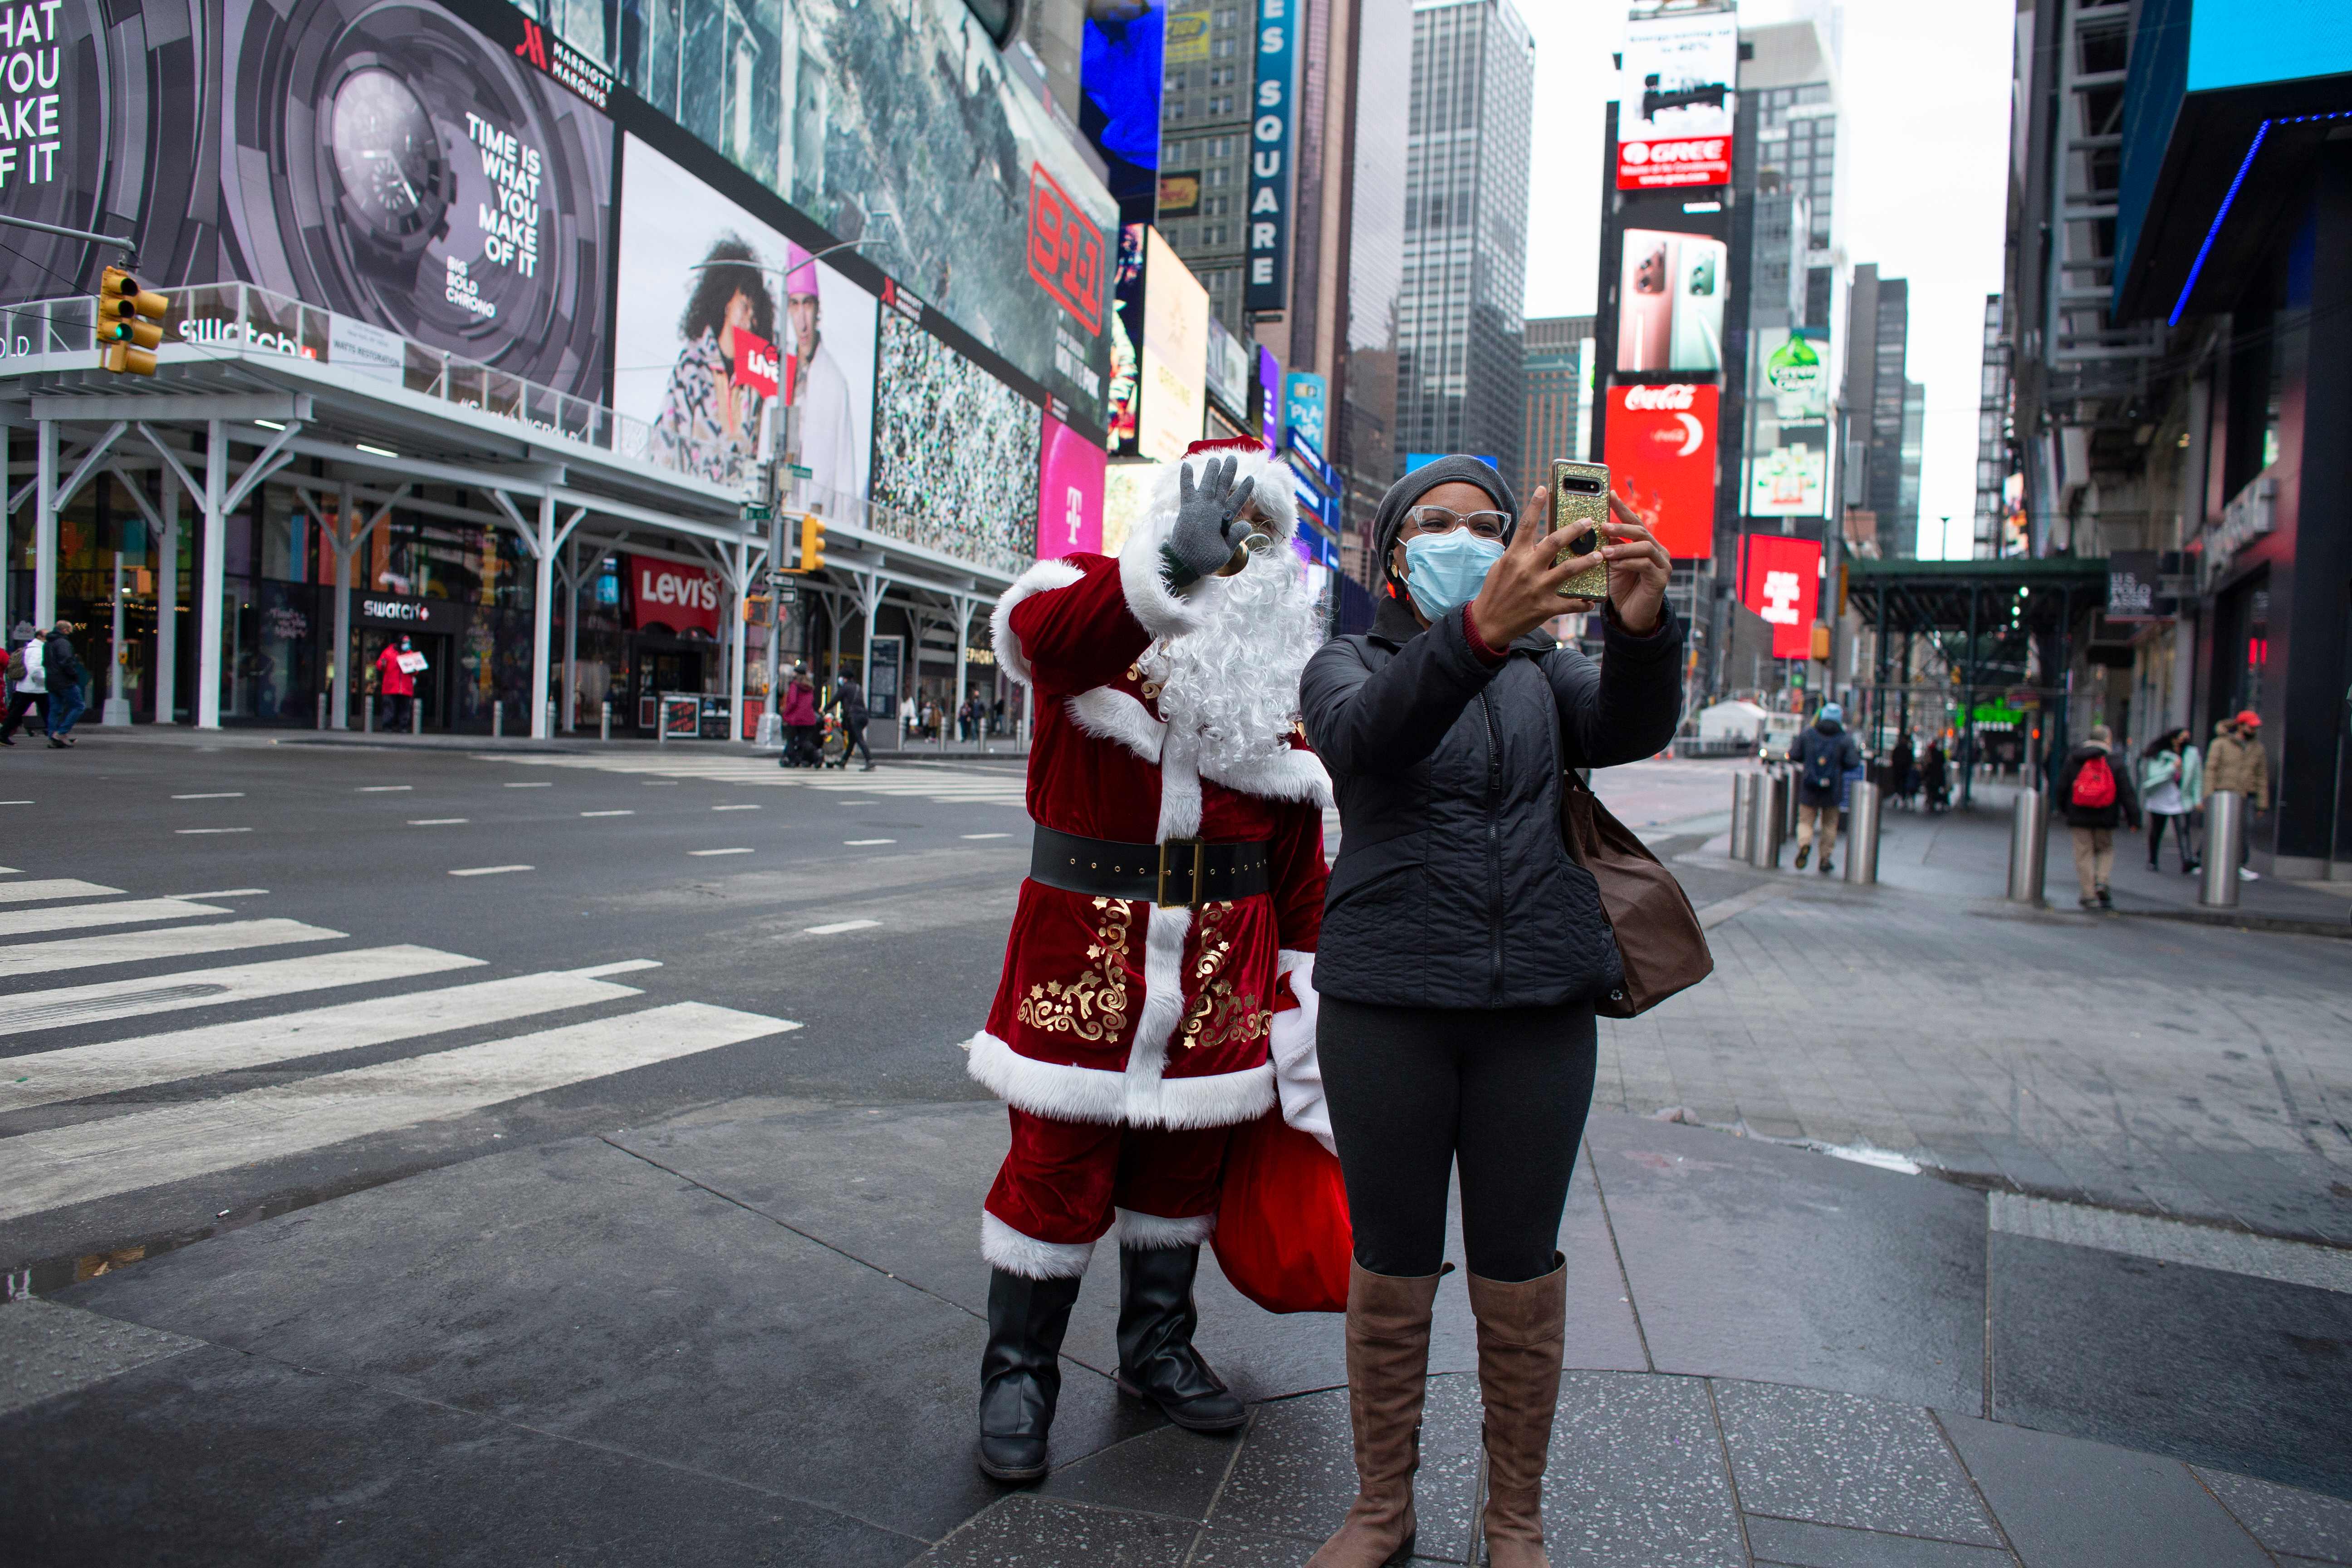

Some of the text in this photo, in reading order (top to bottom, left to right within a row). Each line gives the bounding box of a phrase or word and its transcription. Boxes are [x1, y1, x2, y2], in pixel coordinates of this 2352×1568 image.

[552, 60, 607, 108] MARQUIS
[554, 42, 614, 93] MARRIOTT
[29, 141, 61, 184] IT
[466, 111, 542, 176] TIME IS
[1650, 139, 1725, 163] GREE
[481, 148, 541, 201] WHAT
[1252, 79, 1283, 284] SQUARE
[498, 184, 539, 227] YOU
[479, 203, 538, 255] MAKE
[446, 255, 469, 277] BIG
[485, 235, 538, 278] OF IT
[445, 287, 497, 318] CHRONO
[446, 272, 479, 296] BOLD
